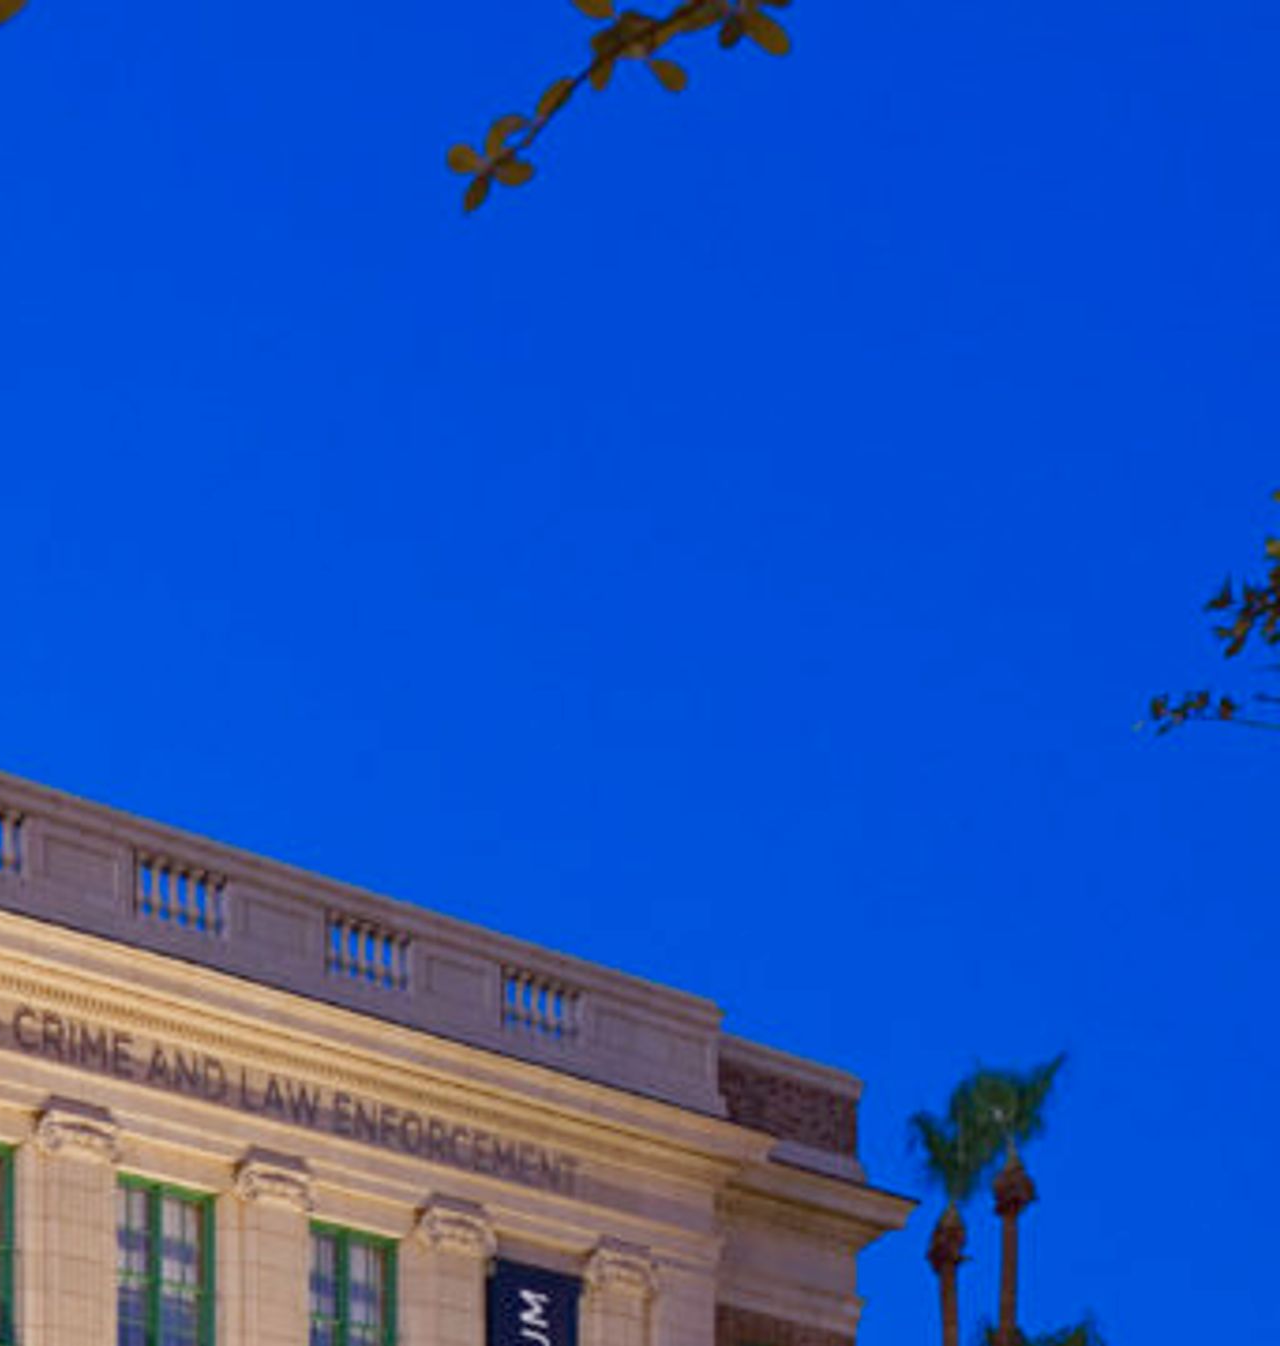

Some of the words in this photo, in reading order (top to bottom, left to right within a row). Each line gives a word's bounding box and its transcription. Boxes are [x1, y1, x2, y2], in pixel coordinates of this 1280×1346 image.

[13, 1004, 134, 1078] CRIME
[146, 1039, 227, 1102] AND
[240, 1064, 321, 1124] LAW
[333, 1090, 582, 1196] ENFORCEMENT
